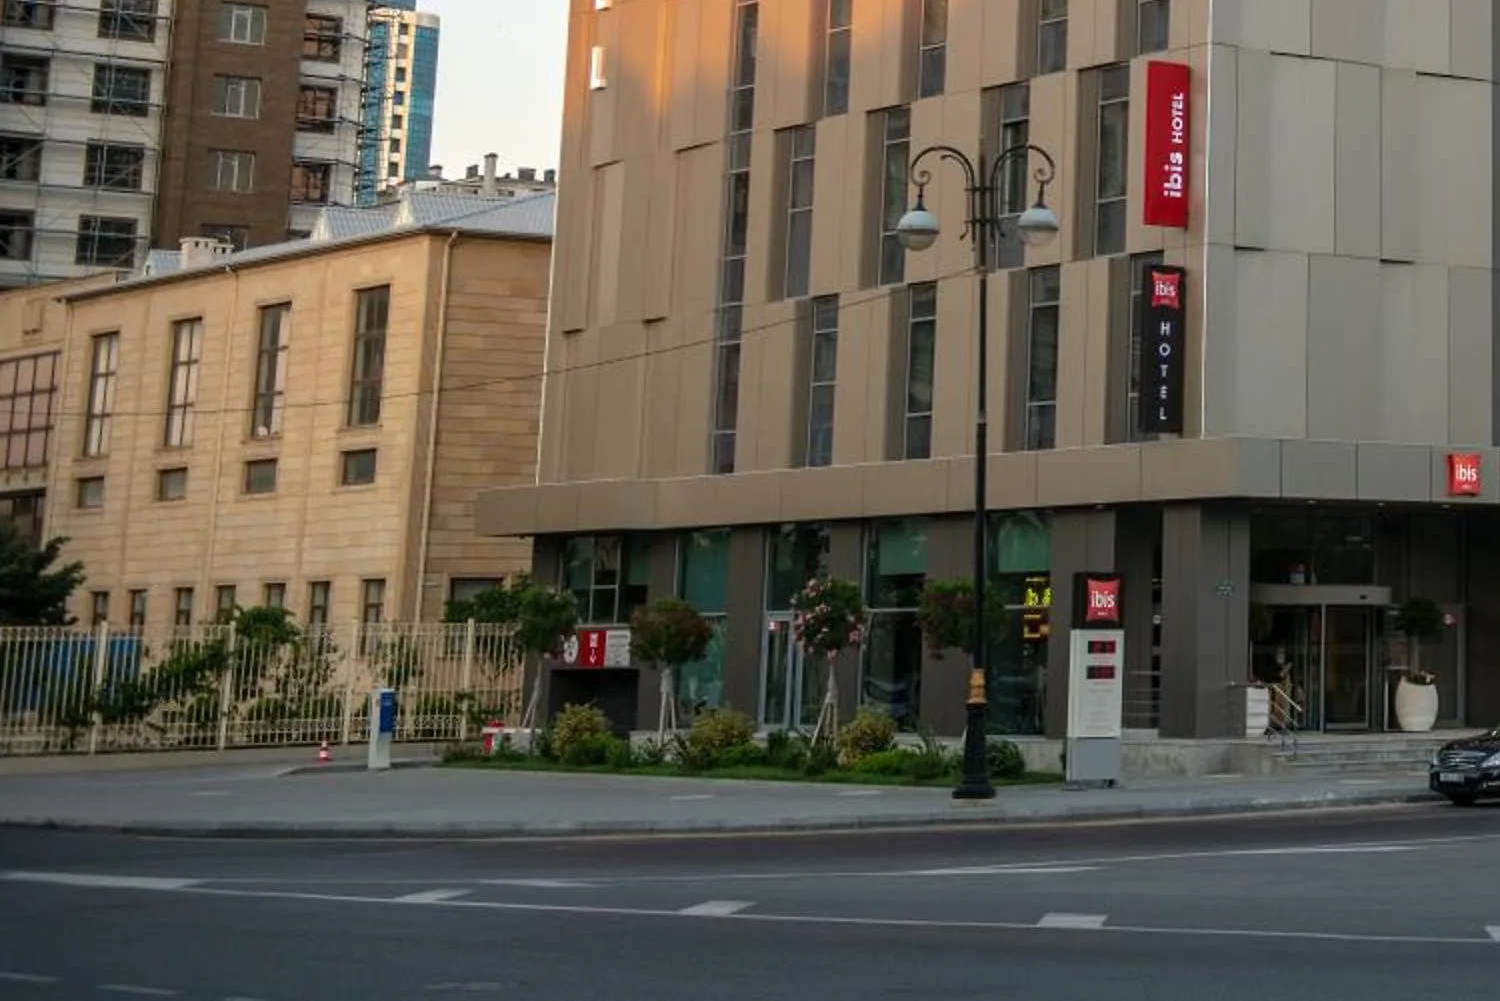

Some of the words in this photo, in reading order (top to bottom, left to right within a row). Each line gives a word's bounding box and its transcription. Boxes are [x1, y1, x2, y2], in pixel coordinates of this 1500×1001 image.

[1171, 92, 1184, 144] HOTEL
[1163, 151, 1183, 198] ibis
[1155, 281, 1176, 297] ibis
[1159, 321, 1171, 420] HOTEL
[1455, 463, 1477, 482] ibis
[1091, 590, 1115, 608] ibis
